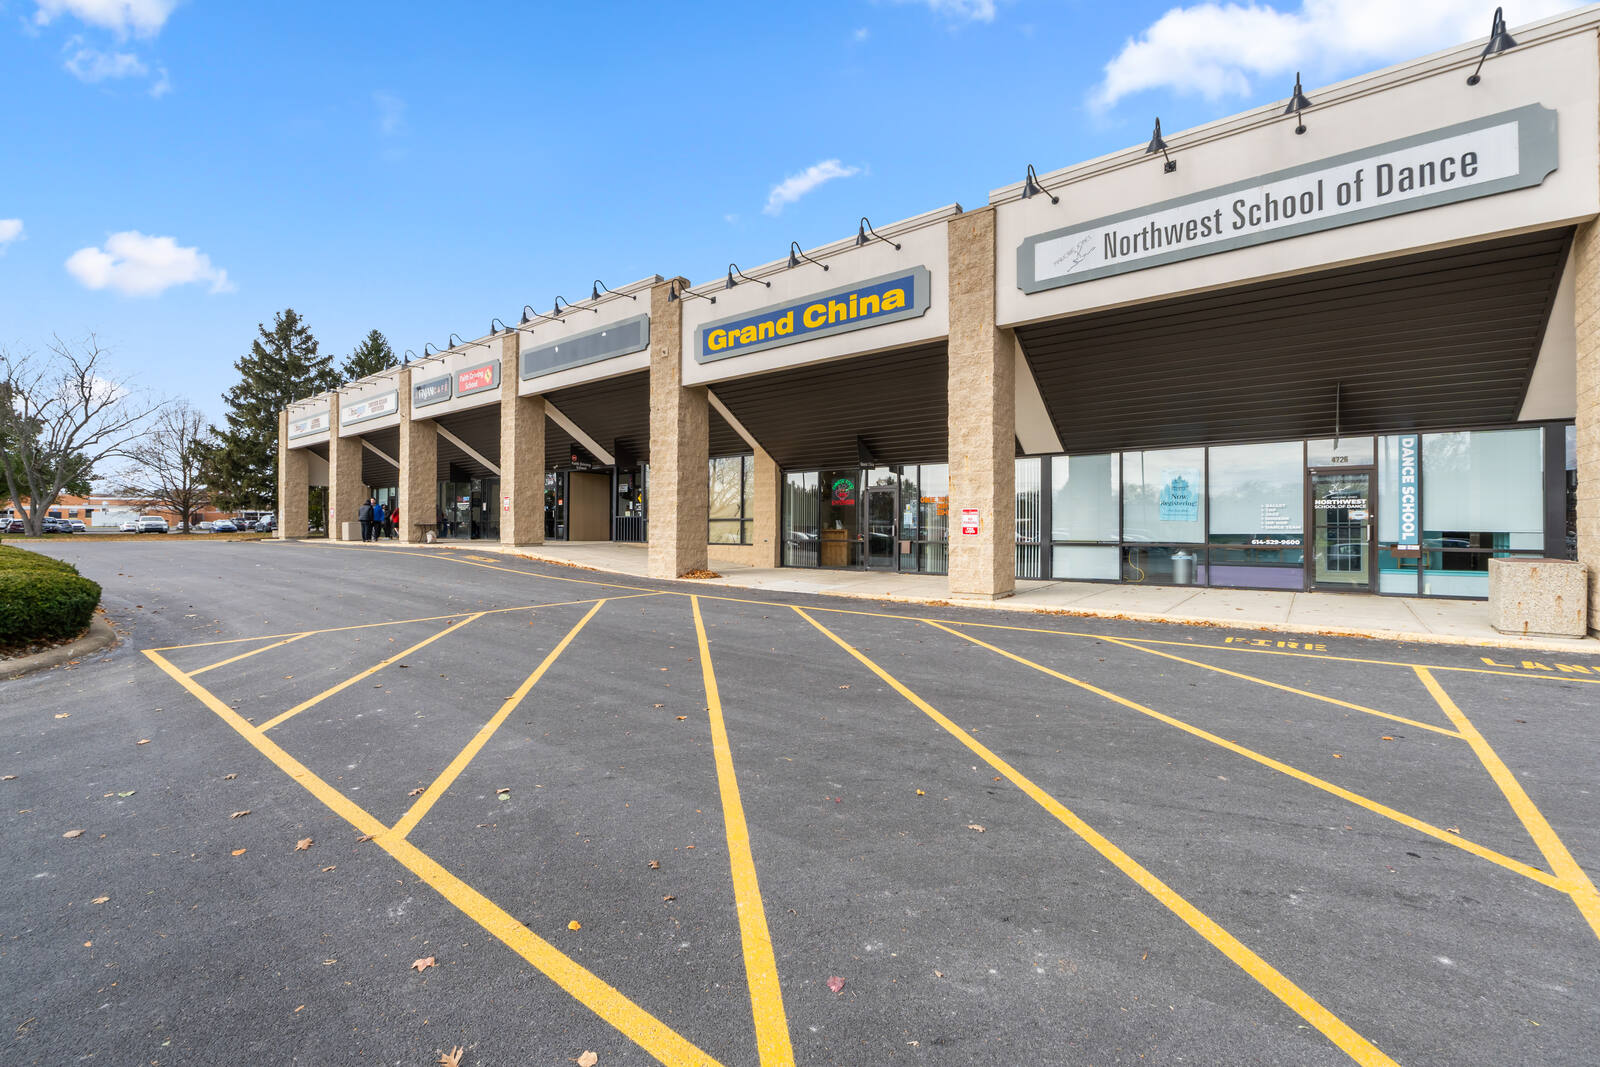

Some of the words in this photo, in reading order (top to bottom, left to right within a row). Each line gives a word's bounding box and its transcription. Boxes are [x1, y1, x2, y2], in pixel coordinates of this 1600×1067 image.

[1103, 207, 1223, 260] Northwest
[1232, 179, 1324, 231] School
[1336, 168, 1365, 207] of
[1376, 150, 1479, 195] Dance
[707, 310, 794, 351] Grand
[803, 287, 906, 328] China
[1401, 437, 1415, 484] DANCE
[1401, 486, 1415, 540] SCHOOL
[1224, 637, 1328, 651] FIRE
[1480, 657, 1600, 674] LAN
